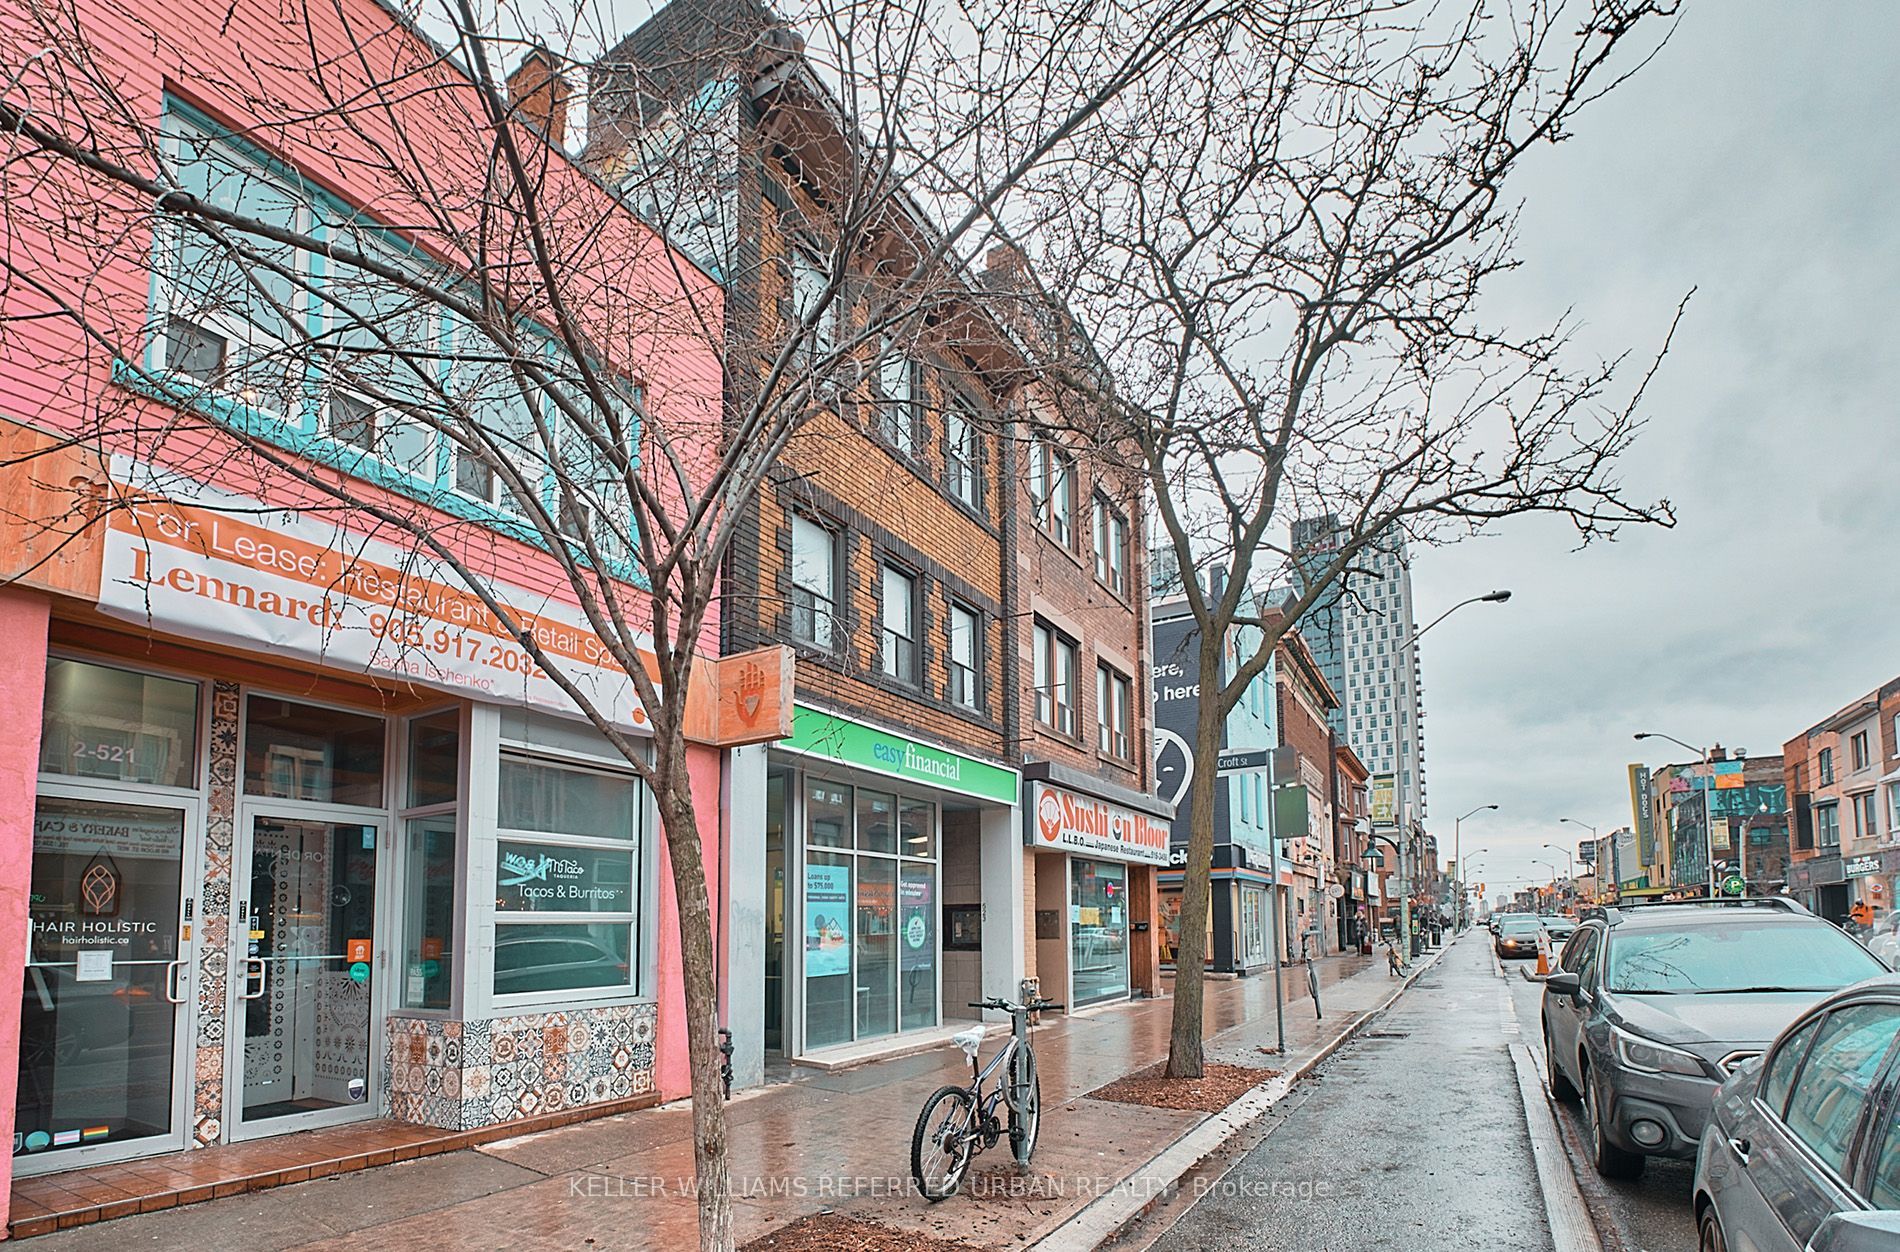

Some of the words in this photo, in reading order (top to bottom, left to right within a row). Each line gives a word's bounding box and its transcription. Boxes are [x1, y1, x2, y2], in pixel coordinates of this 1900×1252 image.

[130, 497, 199, 543] For
[212, 520, 328, 581] Lease:
[340, 560, 489, 627] Restaurant
[521, 617, 578, 654] Retail
[584, 637, 622, 669] Spa
[1164, 684, 1200, 701] here
[73, 741, 135, 764] 2-521
[873, 742, 960, 781] easyfinancial
[1217, 757, 1239, 768] Croft
[1241, 758, 1248, 766] St
[1062, 793, 1108, 838] Sushi
[1134, 814, 1168, 850] Bloor
[1094, 839, 1119, 853] Japanese
[1120, 844, 1145, 858] Restaurant
[517, 883, 555, 898] Tacos
[556, 884, 566, 898] &
[569, 885, 615, 900] Burritos
[32, 921, 76, 934] HAIR
[82, 921, 157, 934] HOLISTIC
[61, 935, 130, 946] hairholistic.ca
